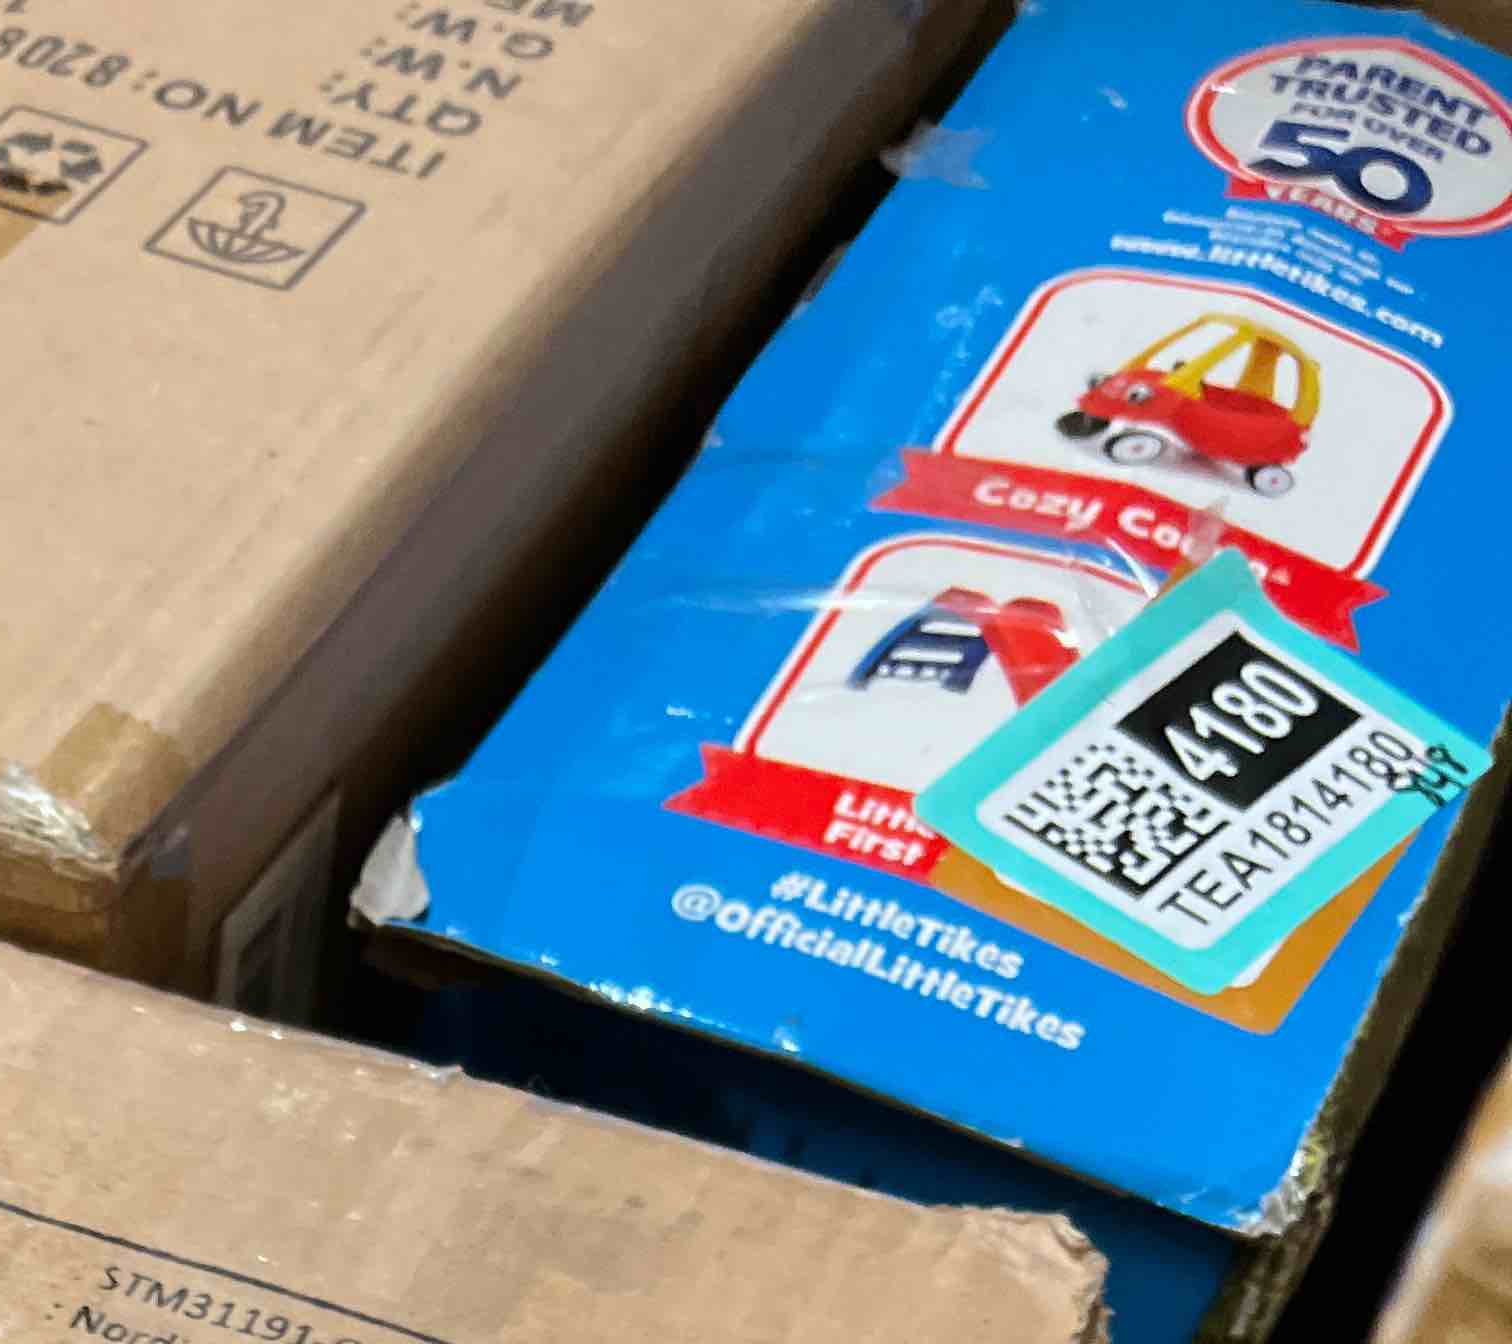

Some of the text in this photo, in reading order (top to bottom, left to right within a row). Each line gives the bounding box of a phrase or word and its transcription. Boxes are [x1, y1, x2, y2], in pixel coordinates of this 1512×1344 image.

[319, 71, 482, 137] QTY:
[360, 37, 523, 100] N.W:
[1294, 55, 1493, 126] PARENT
[266, 109, 447, 180] ITEM
[1270, 73, 1493, 156] TRUSTED
[1362, 116, 1444, 163] OVER
[1247, 120, 1434, 215] 50
[973, 476, 1103, 533] Cozy
[1163, 659, 1320, 782] 4180
[824, 820, 926, 867] First
[1157, 730, 1415, 926] TEA1814180
[769, 870, 1025, 980] #LittleTikes
[671, 883, 1086, 1050] @OfficialLittleTikes
